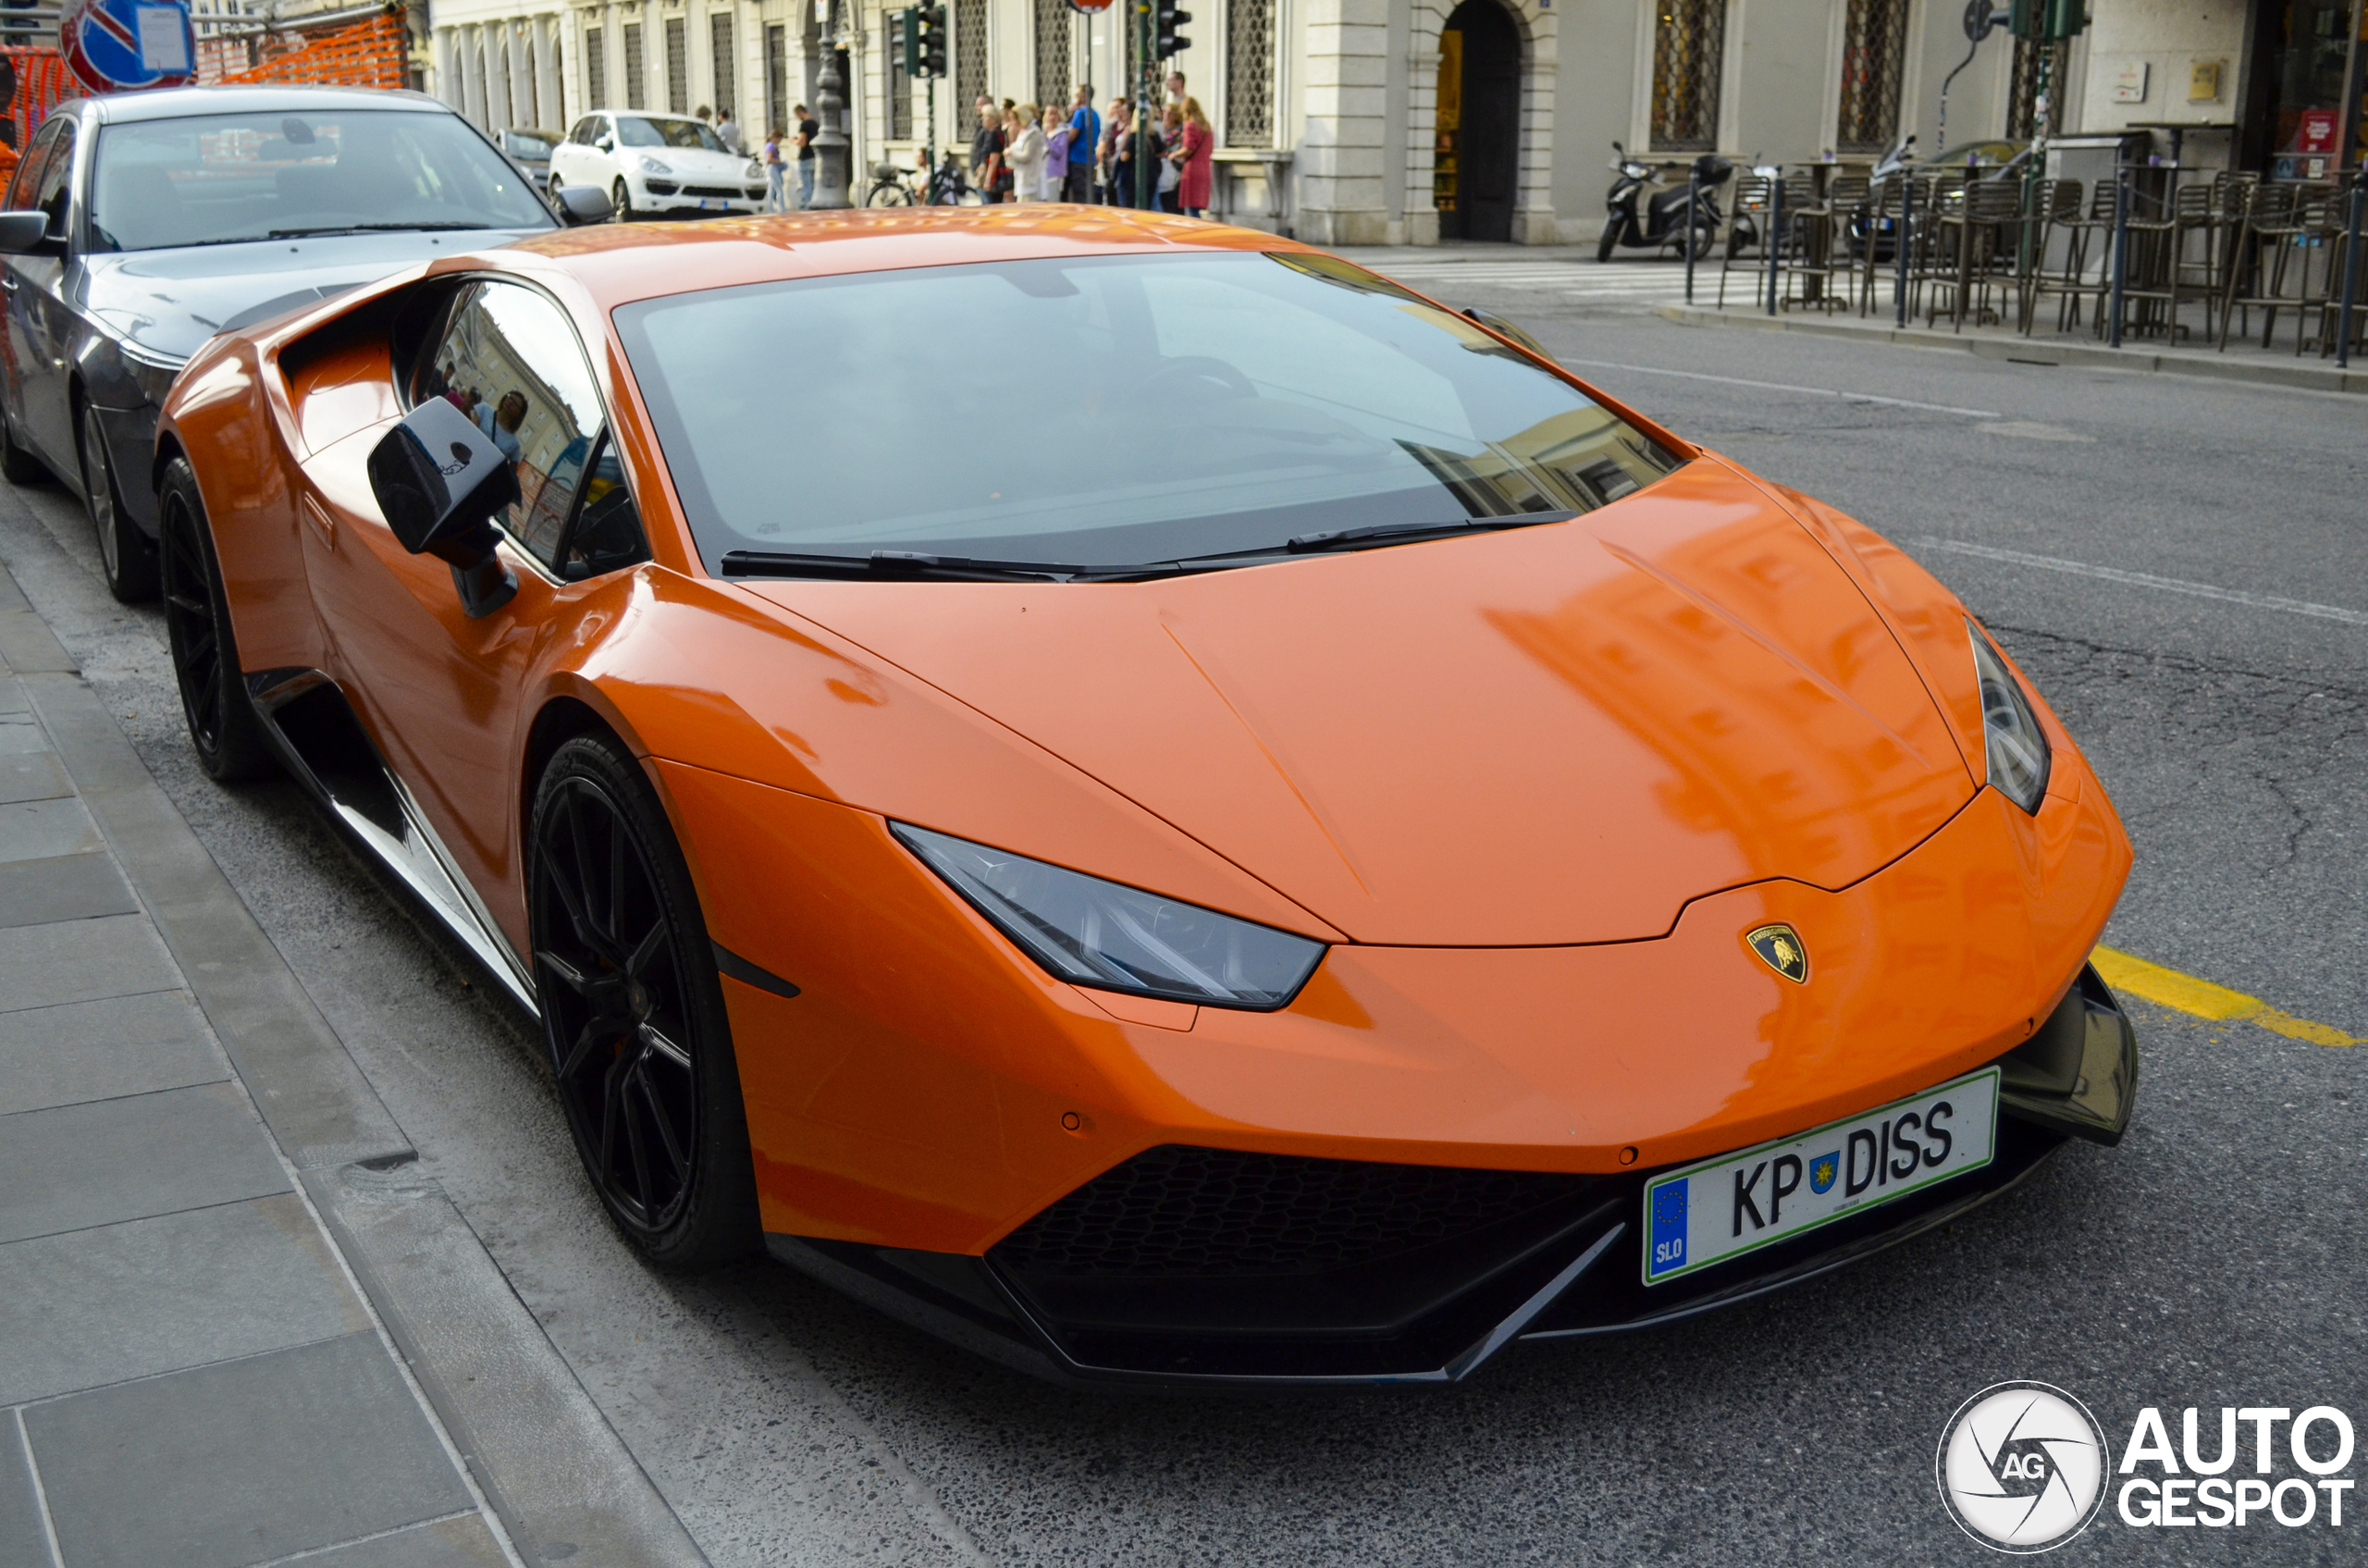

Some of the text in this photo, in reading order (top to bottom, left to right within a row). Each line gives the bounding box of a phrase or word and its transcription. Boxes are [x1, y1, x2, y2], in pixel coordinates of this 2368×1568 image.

[1750, 928, 1791, 944] LAMBORGHINI
[1732, 1101, 1954, 1238] KP DISS
[1656, 1238, 1683, 1264] SLO
